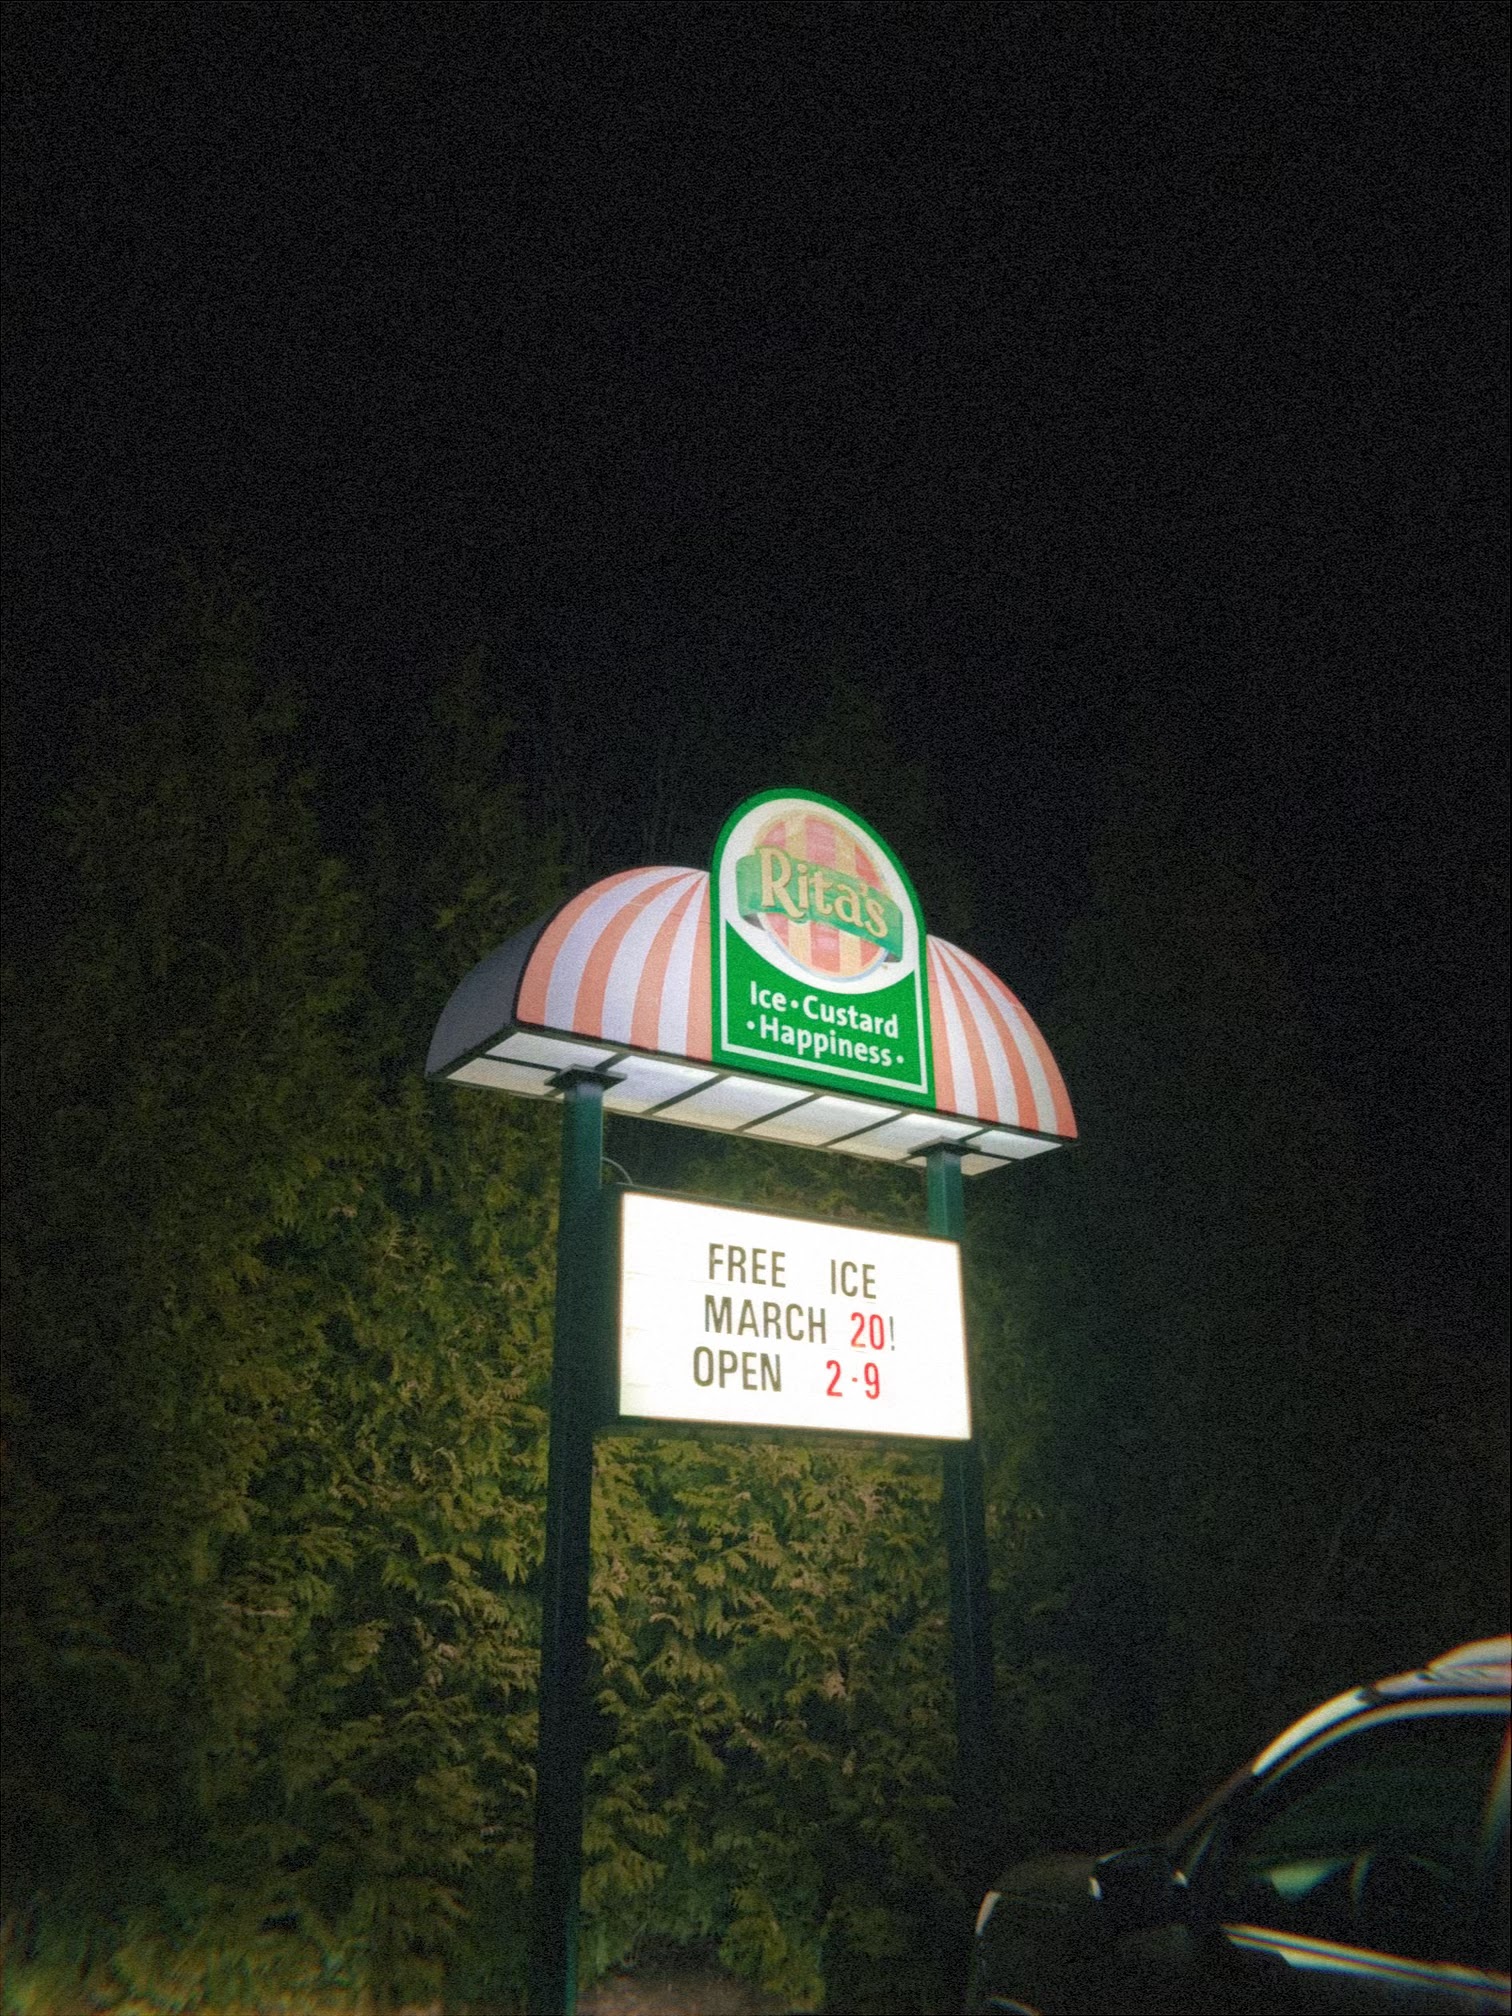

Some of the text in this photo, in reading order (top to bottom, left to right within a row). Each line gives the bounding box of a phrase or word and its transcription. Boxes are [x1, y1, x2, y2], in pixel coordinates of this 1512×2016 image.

[759, 846, 888, 938] Rita's
[708, 1243, 877, 1299] FREE ICE
[704, 1294, 896, 1351] MARCH 20!
[693, 1346, 782, 1392] OPEN
